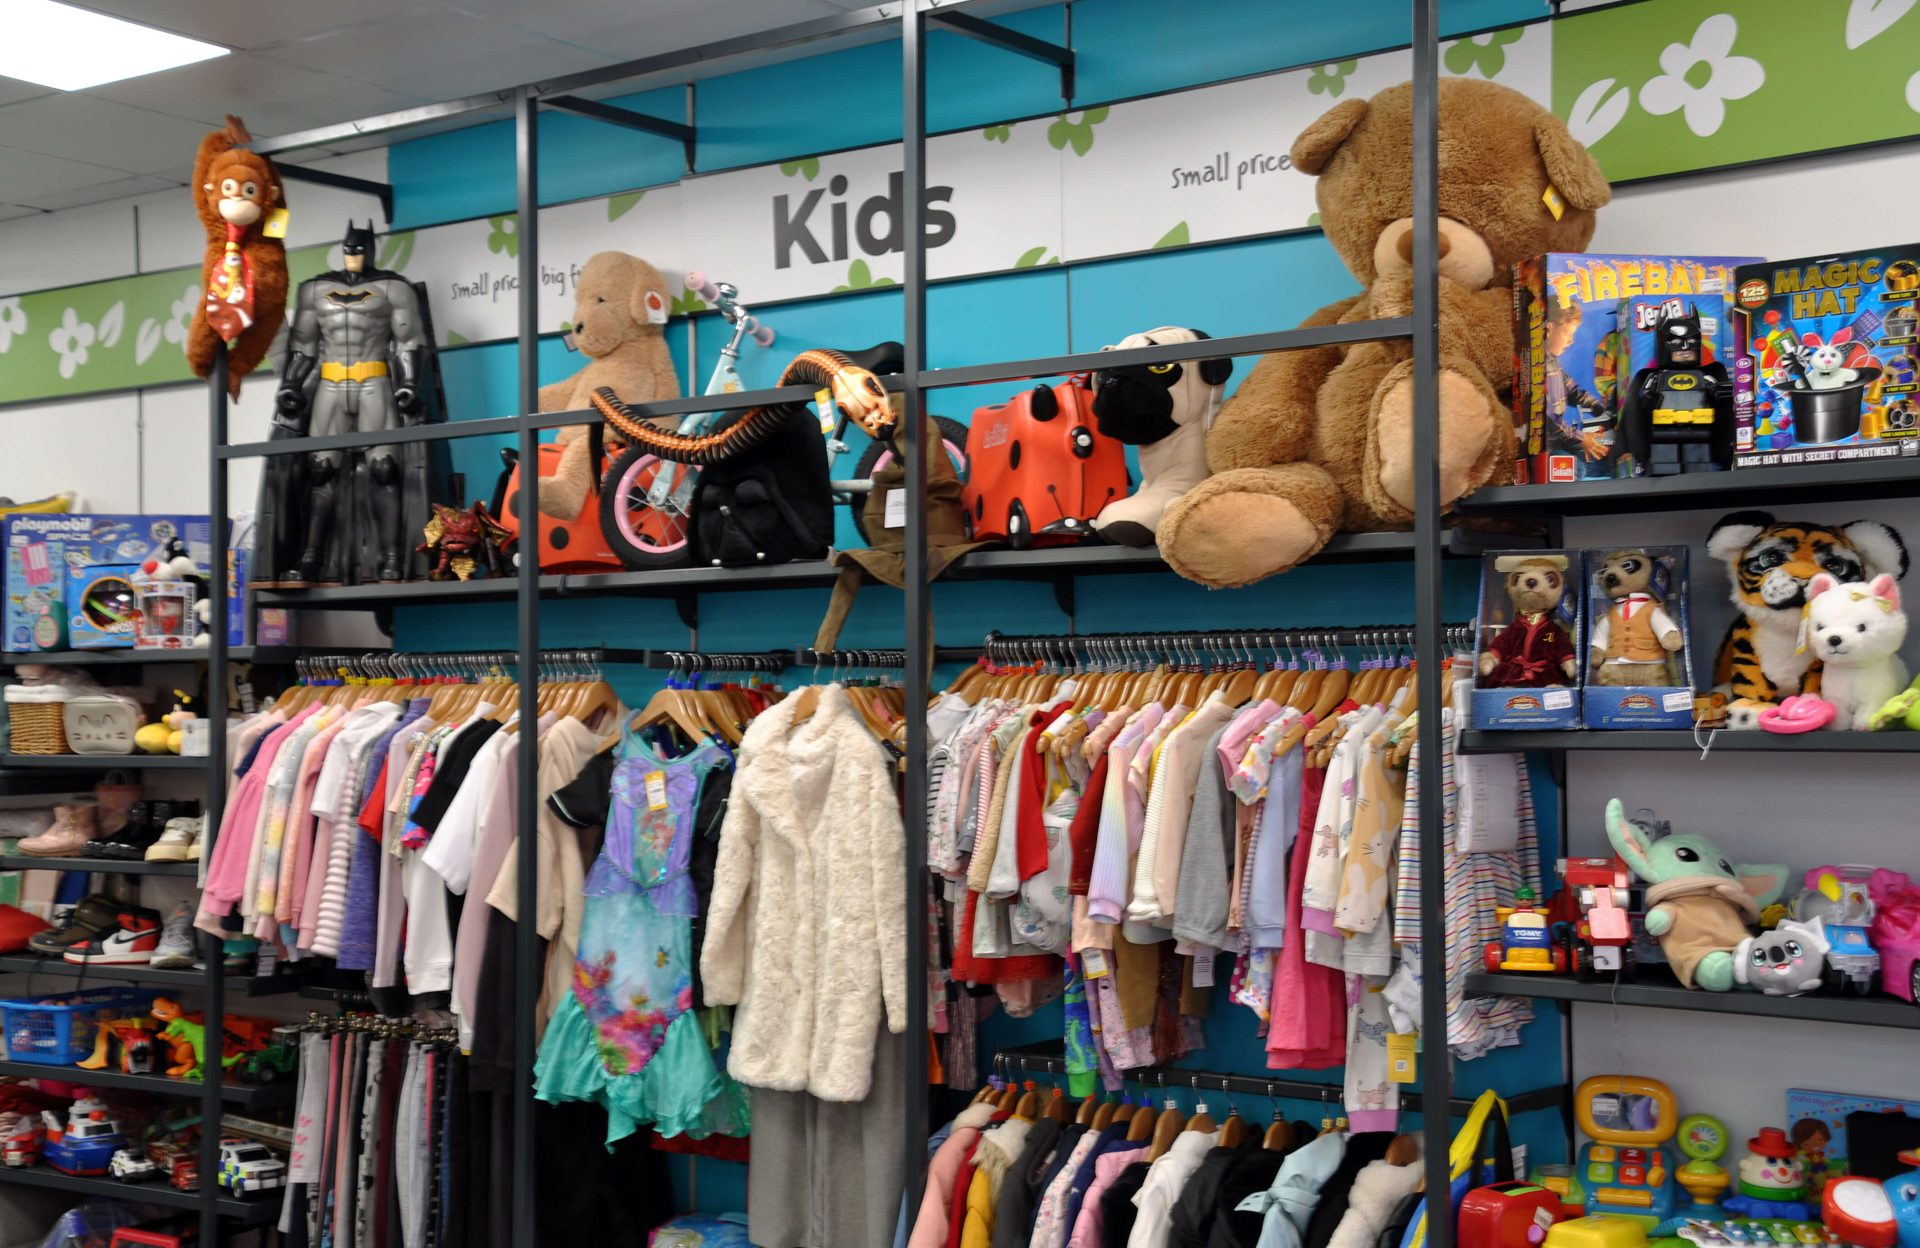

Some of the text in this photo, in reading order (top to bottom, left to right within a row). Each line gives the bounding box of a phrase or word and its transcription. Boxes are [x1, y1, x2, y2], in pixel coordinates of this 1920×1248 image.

[1171, 152, 1229, 189] small
[773, 171, 957, 270] Kids
[451, 272, 489, 300] small
[493, 275, 520, 303] pric
[541, 265, 565, 296] big
[1773, 259, 1881, 296] MAGIC
[1739, 284, 1767, 297] 125
[1792, 287, 1861, 321] HAT
[1737, 455, 1761, 467] MAGIC
[1762, 453, 1779, 465] HAT
[1781, 452, 1803, 464] WITH
[1805, 450, 1836, 462] SECRET
[1837, 445, 1898, 460] COMPARTMENT
[11, 517, 92, 534] playmobil
[1512, 929, 1544, 937] TOMY
[1626, 1149, 1639, 1157] 2
[1625, 1167, 1638, 1178] 4
